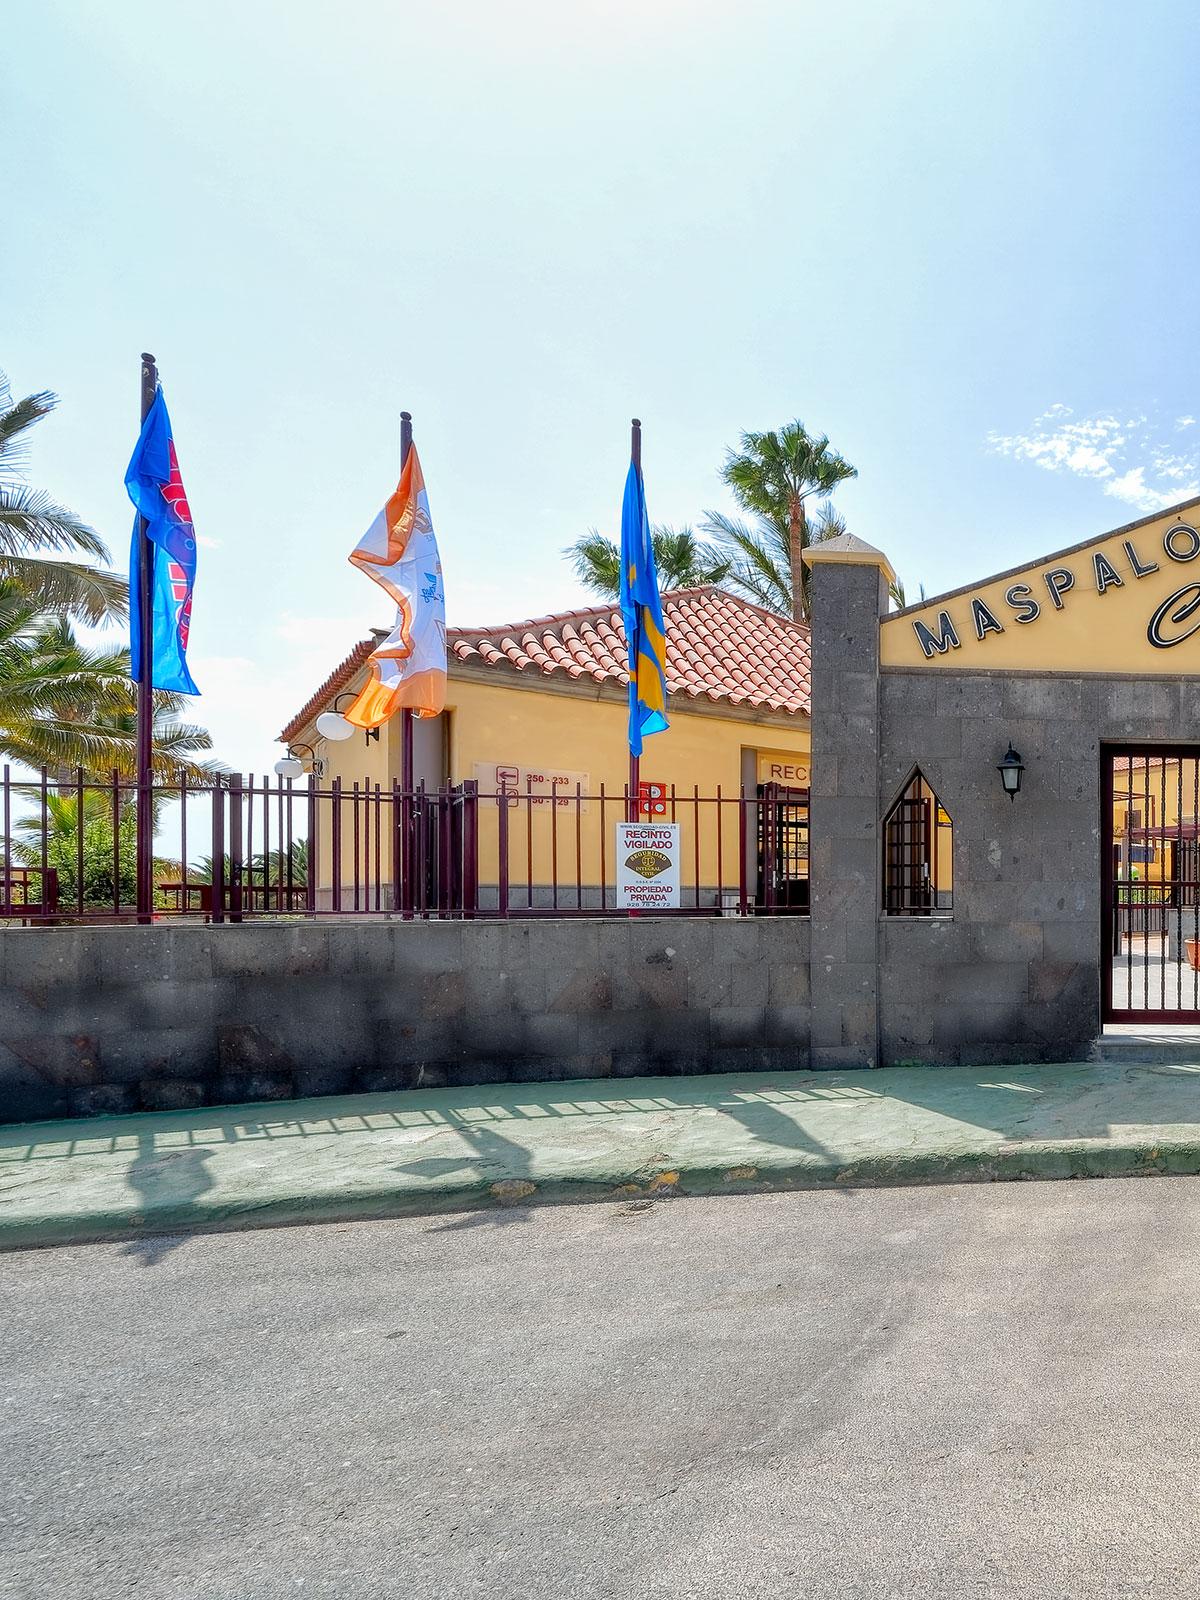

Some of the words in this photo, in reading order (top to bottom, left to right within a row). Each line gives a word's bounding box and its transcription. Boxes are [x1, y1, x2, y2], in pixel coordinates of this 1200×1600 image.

[526, 774, 544, 783] 250
[552, 776, 569, 785] 233
[625, 830, 672, 839] RECINTO
[624, 840, 673, 849] VIGILADO
[630, 850, 667, 862] SEGURIDAD
[624, 885, 673, 893] PROPIEDAD
[630, 894, 667, 902] PRIVADA
